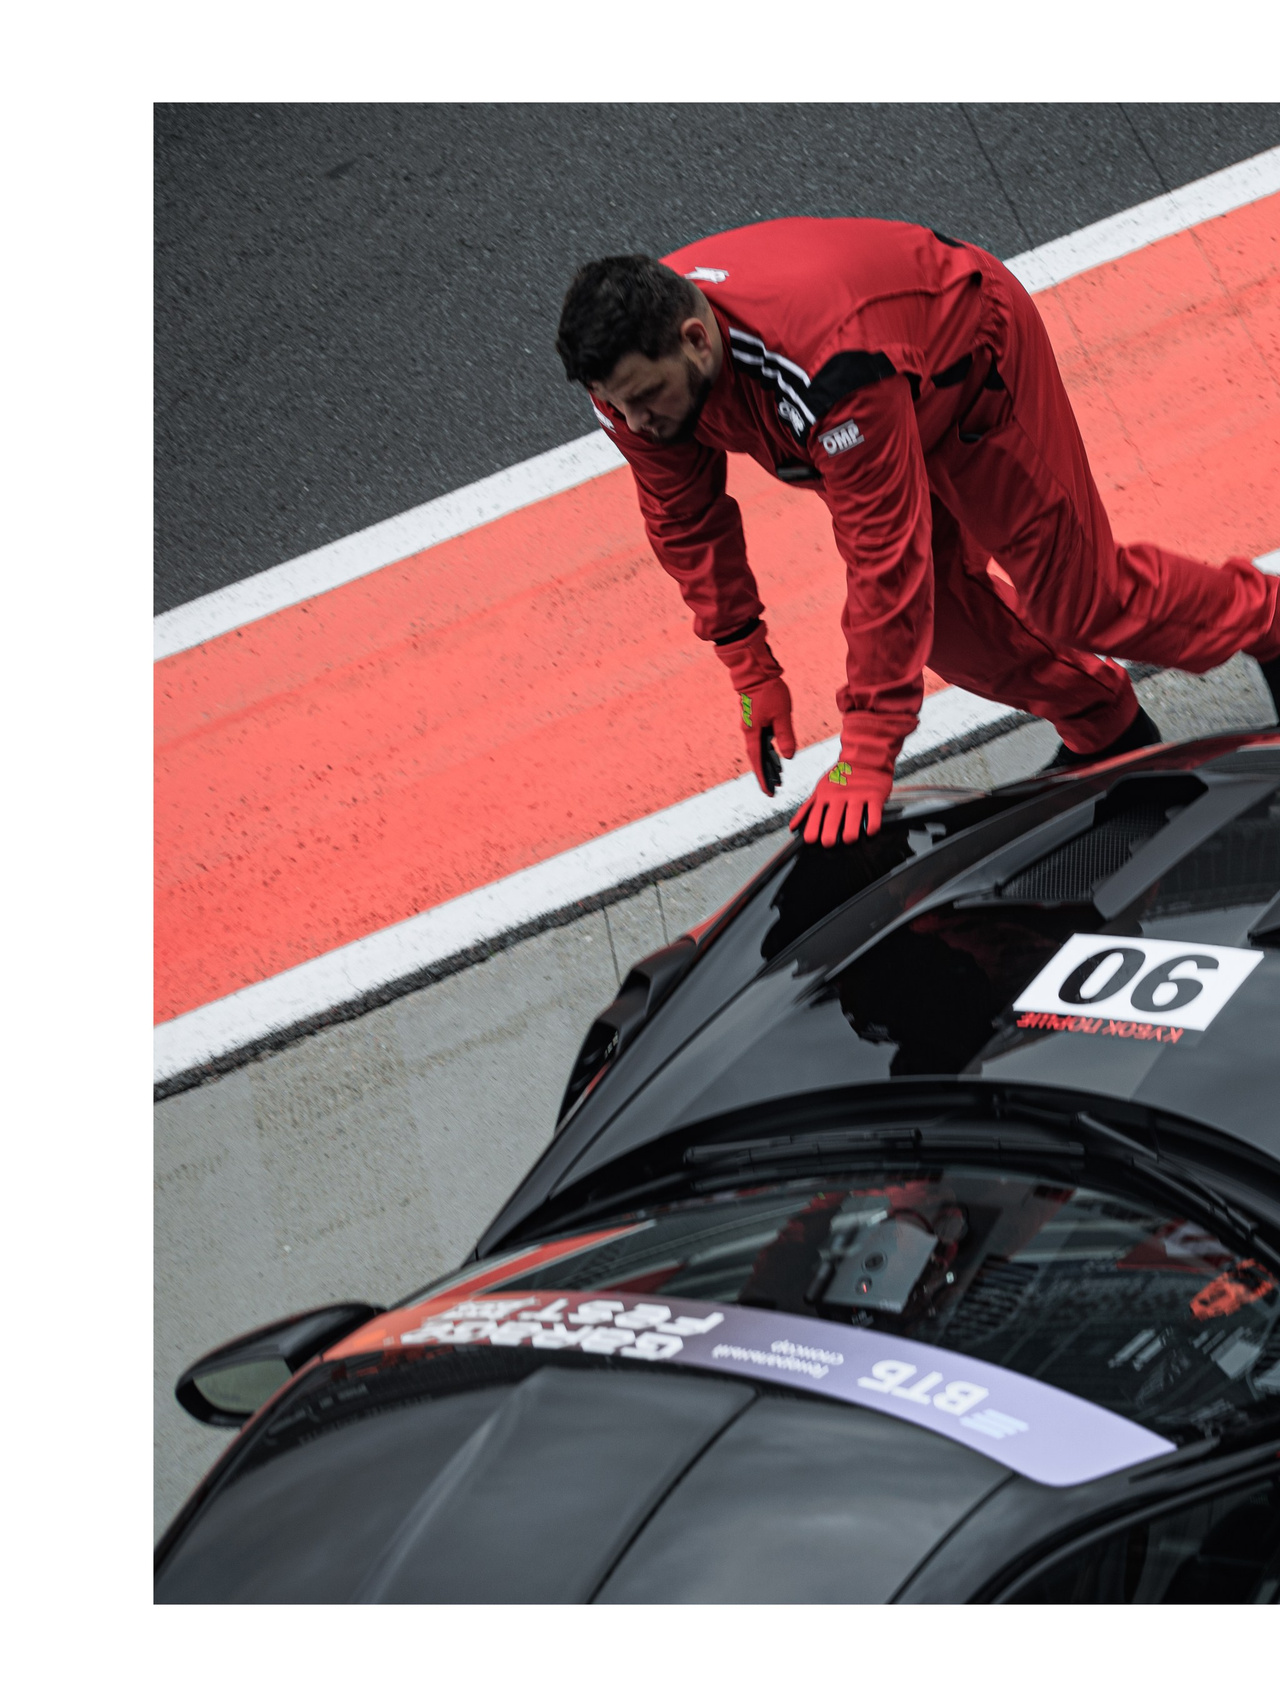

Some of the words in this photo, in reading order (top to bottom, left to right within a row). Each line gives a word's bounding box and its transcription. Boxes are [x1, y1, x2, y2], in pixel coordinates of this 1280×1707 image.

[822, 422, 860, 455] OMP
[1058, 947, 1220, 1013] 90
[1101, 1018, 1184, 1044] КУБОК
[856, 1359, 990, 1417] ВТБ
